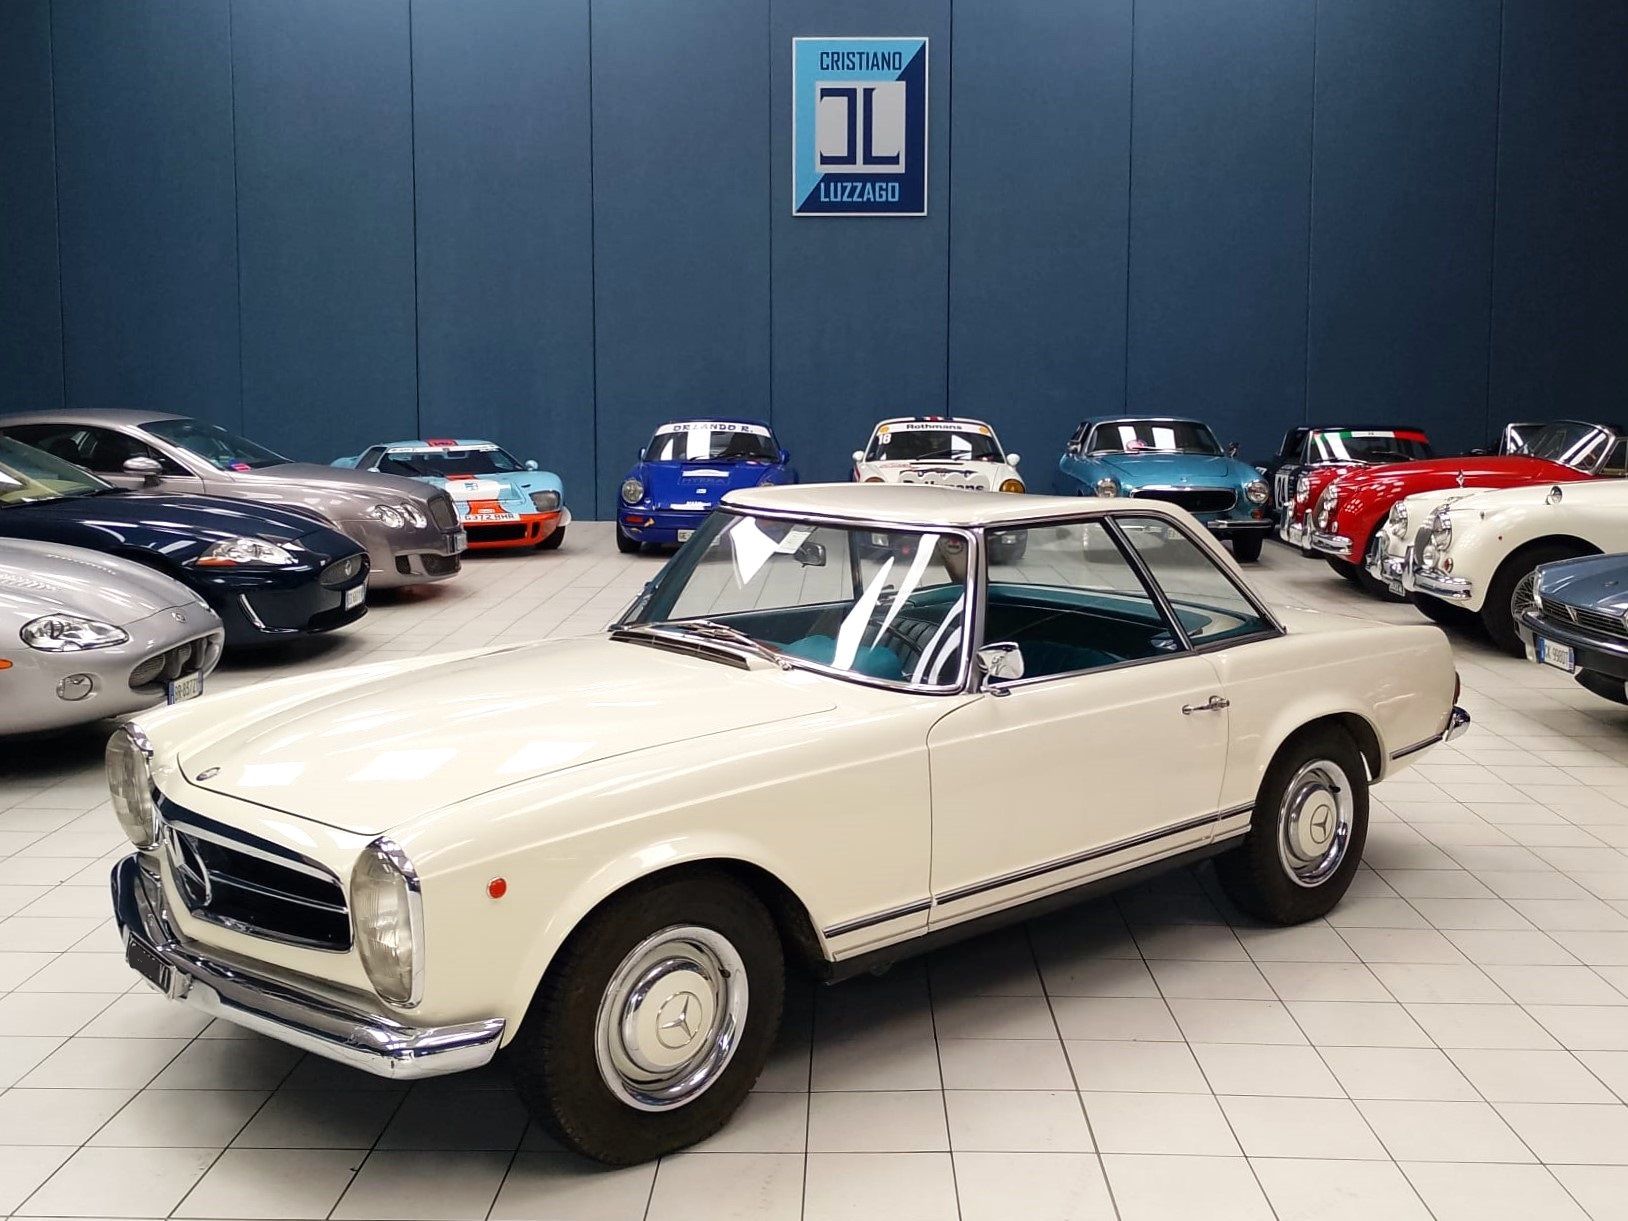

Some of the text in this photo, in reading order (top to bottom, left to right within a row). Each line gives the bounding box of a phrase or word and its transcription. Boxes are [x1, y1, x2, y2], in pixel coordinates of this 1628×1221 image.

[820, 51, 902, 71] CRISTIANO
[820, 182, 899, 202] LUZZAGO
[878, 433, 891, 445] 18
